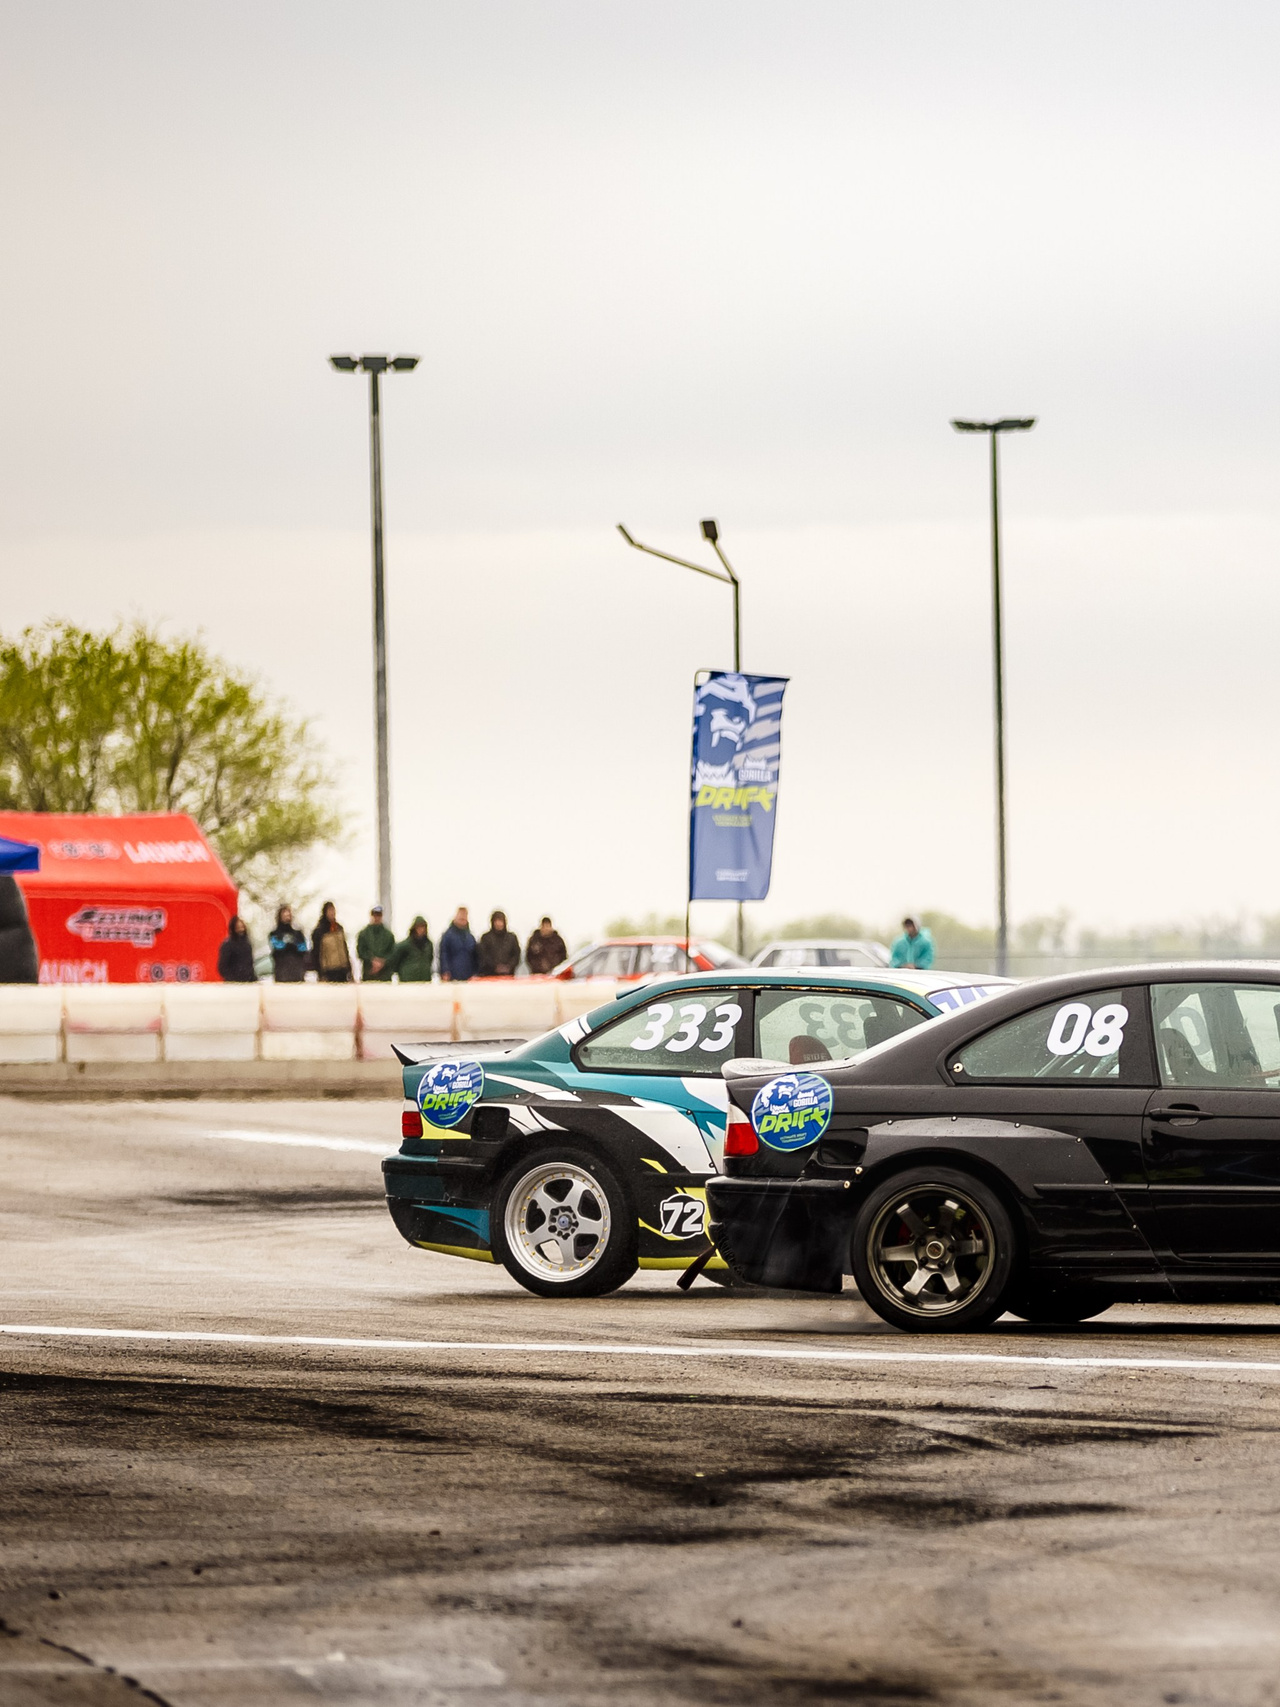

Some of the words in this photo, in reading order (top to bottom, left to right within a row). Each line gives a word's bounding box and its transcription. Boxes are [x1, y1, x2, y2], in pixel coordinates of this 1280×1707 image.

[124, 841, 209, 863] LAUNCH
[38, 959, 109, 982] AUNCH
[629, 1003, 743, 1053] 333
[1047, 1003, 1129, 1057] 08
[793, 1096, 819, 1108] GORILLA
[663, 1201, 704, 1233] 72
